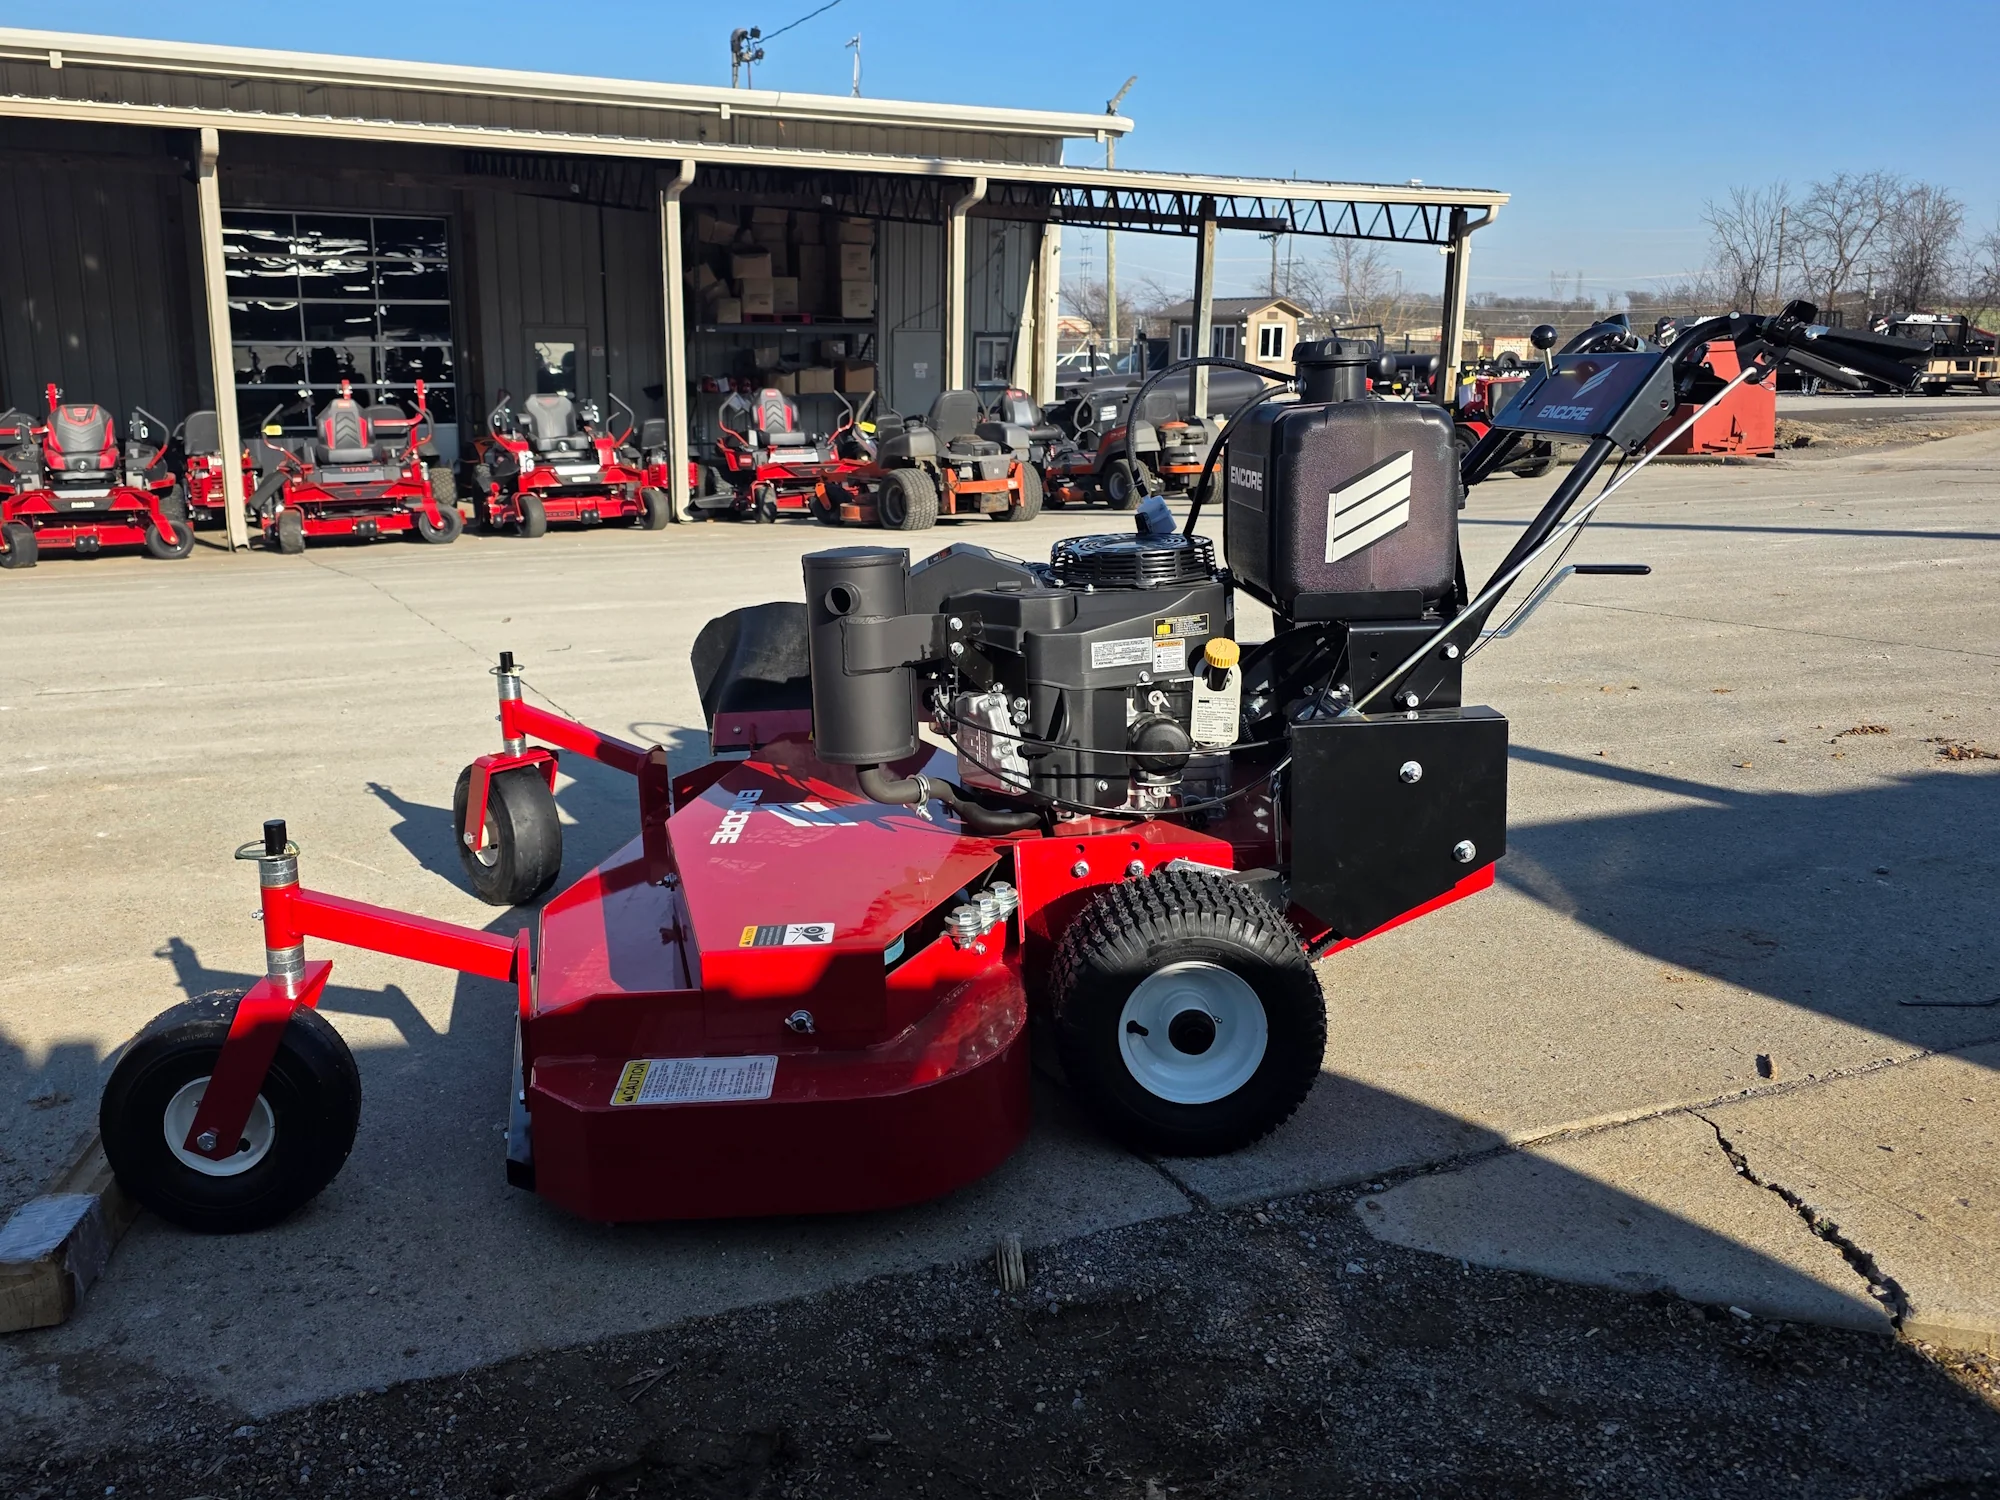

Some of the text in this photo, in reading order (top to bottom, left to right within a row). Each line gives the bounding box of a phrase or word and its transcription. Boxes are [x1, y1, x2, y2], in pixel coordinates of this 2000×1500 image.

[1537, 404, 1594, 421] ENCORE
[1230, 465, 1263, 492] ENCORE
[709, 789, 763, 845] ENCORE
[623, 1062, 646, 1096] CAUTION
